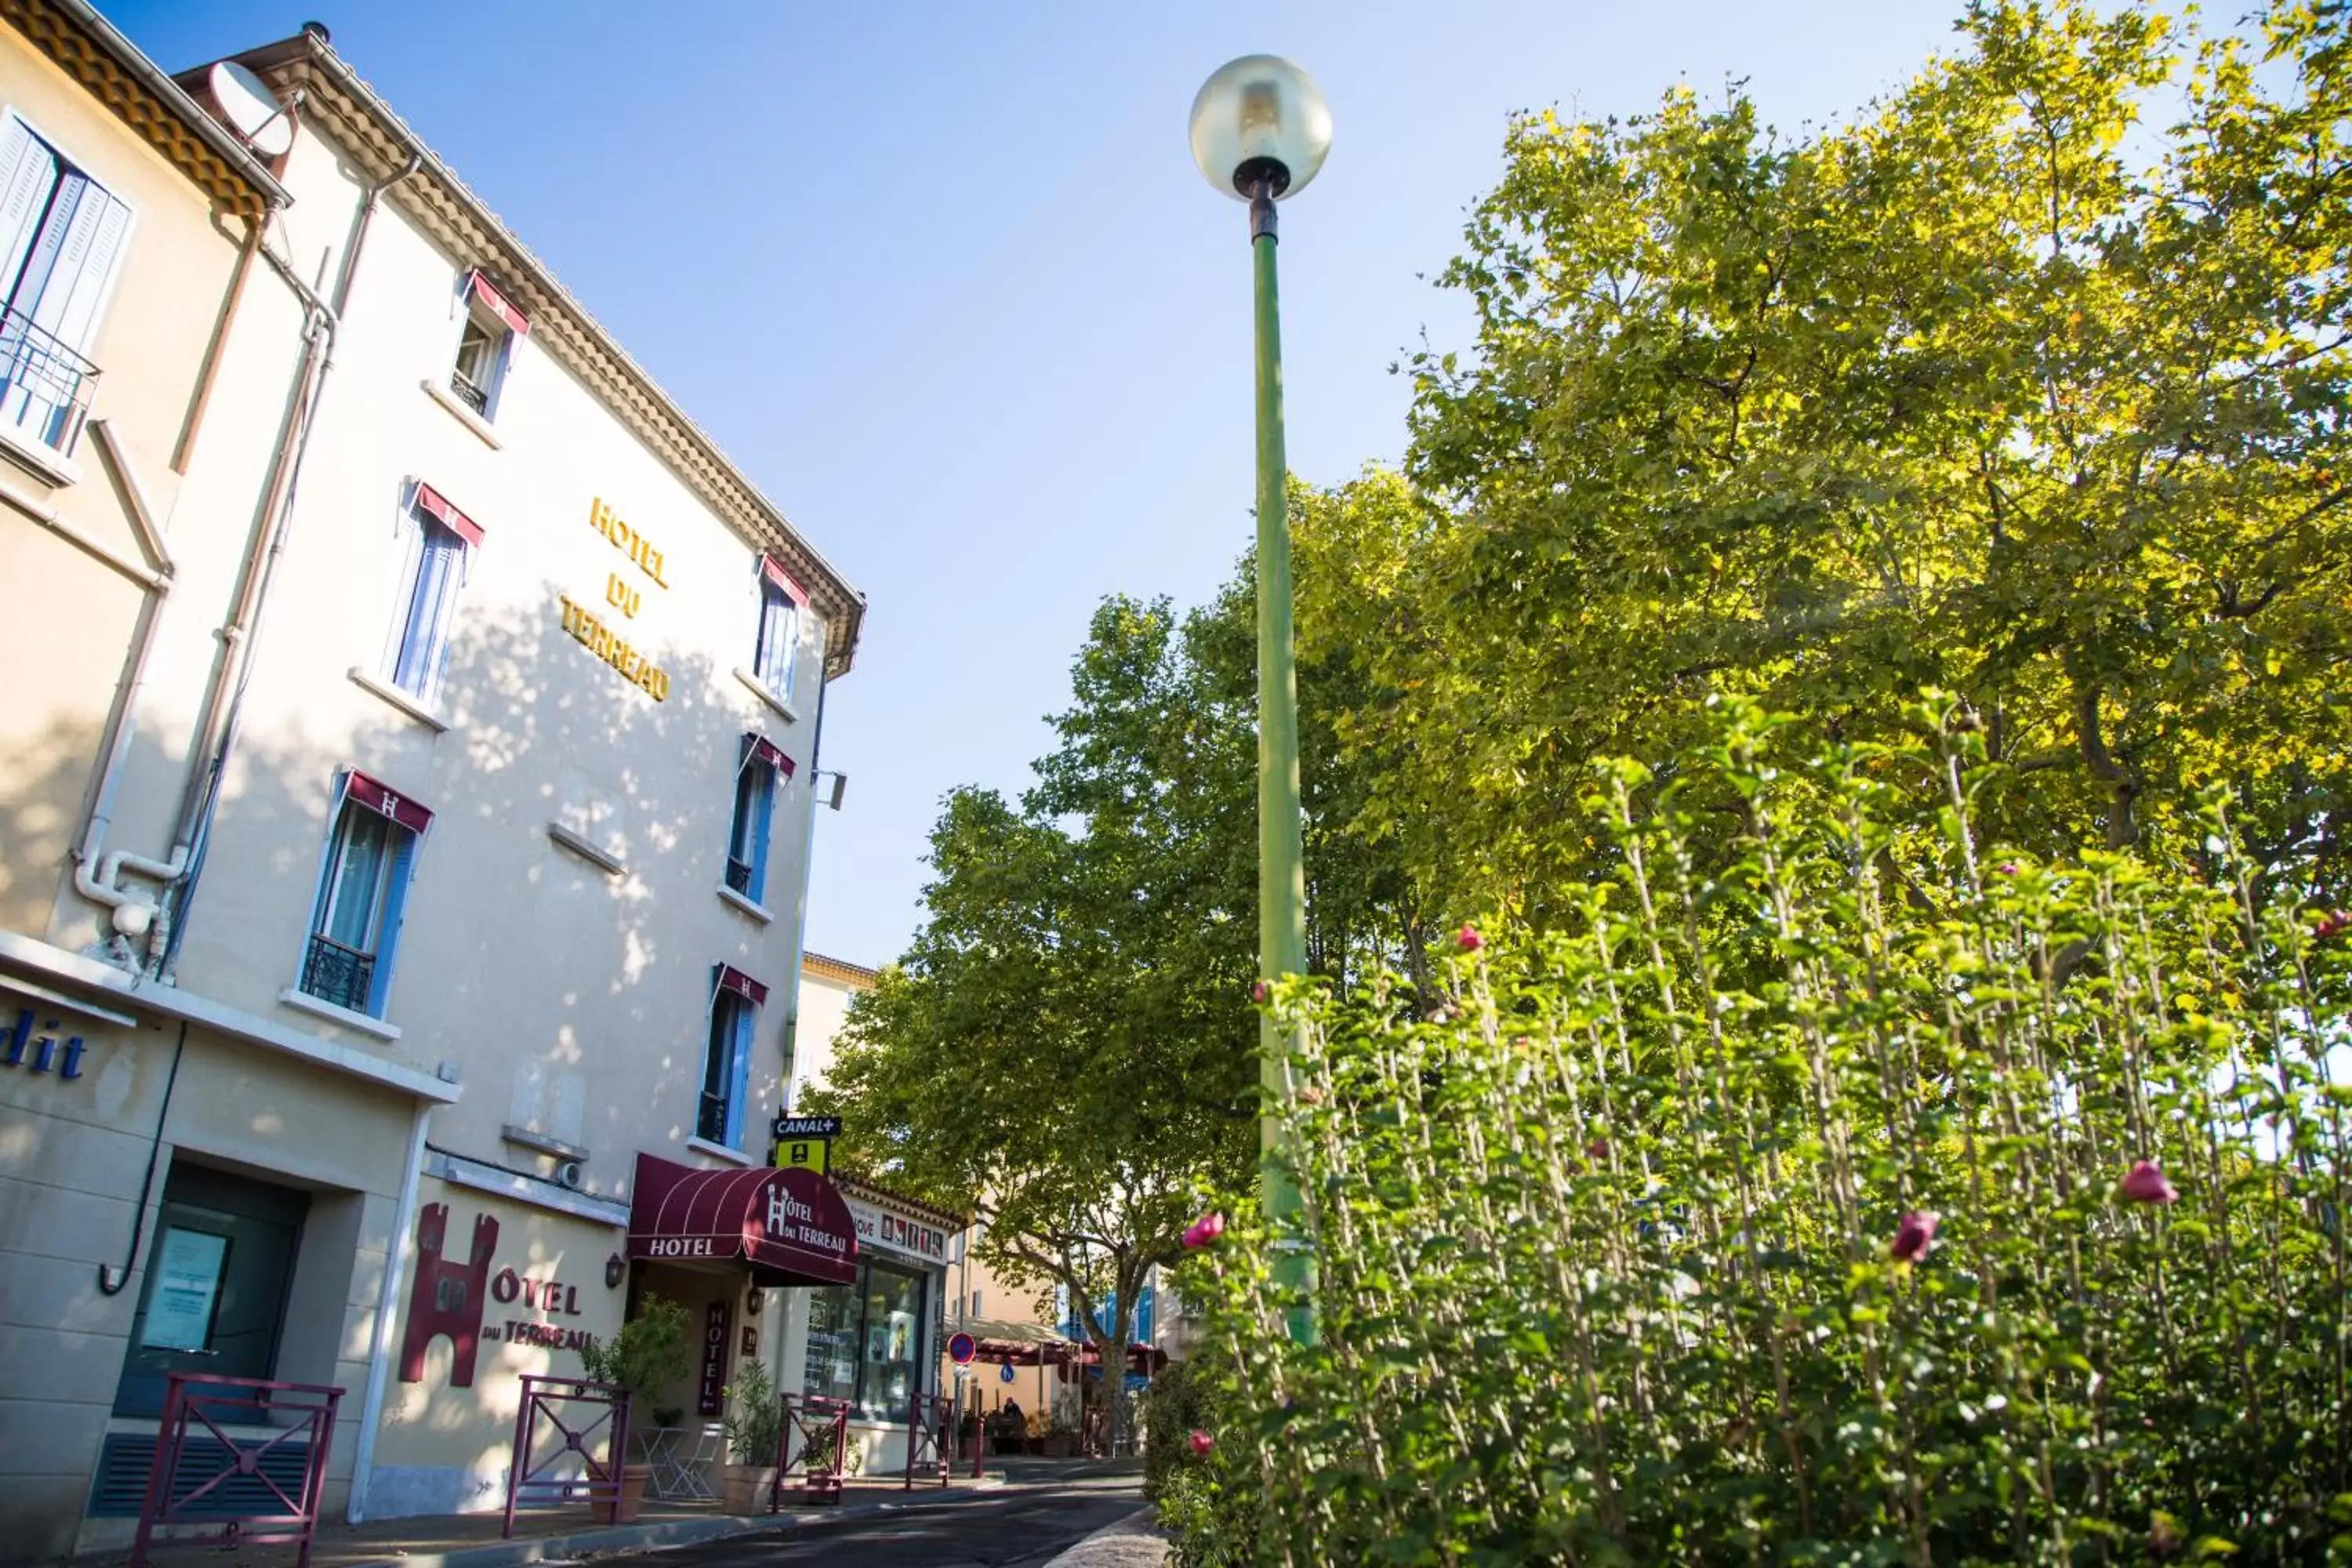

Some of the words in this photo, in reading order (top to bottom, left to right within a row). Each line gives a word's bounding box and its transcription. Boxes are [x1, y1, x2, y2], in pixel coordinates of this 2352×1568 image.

[589, 496, 670, 590] HOTEL
[606, 572, 641, 619] DU
[560, 594, 670, 702] TERREAU
[382, 791, 399, 818] H
[777, 1119, 835, 1134] CANAL+
[650, 1239, 713, 1255] HOTEL
[798, 1225, 847, 1253] TERREAU
[705, 1309, 722, 1396] HOTEL
